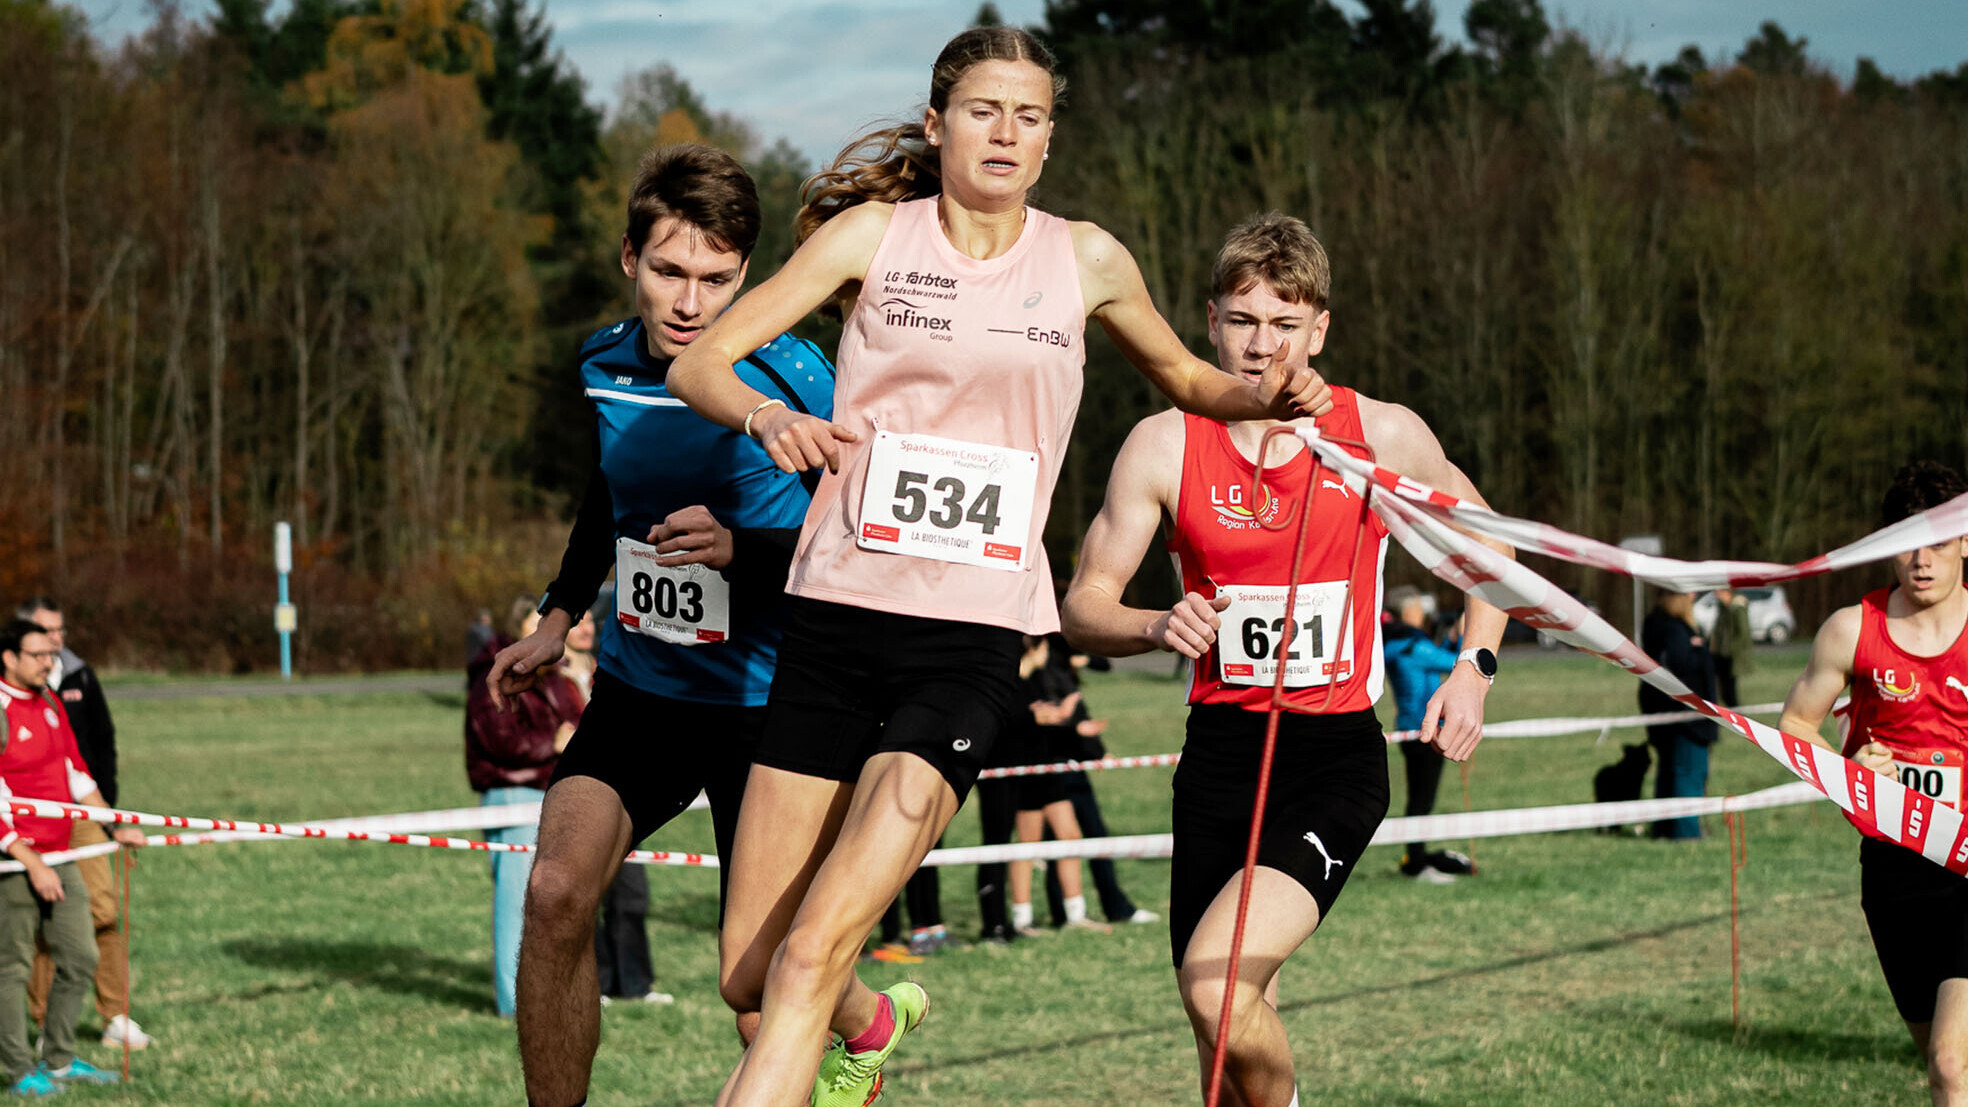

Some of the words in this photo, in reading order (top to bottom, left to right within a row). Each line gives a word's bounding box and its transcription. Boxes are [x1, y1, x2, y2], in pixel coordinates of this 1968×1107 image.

[883, 286, 957, 300] Nordschwarzwald
[886, 308, 952, 331] infinex
[929, 332, 953, 343] Group
[1027, 327, 1070, 348] EnBW
[615, 375, 633, 386] JAKO
[900, 440, 958, 458] Sparkassen
[959, 450, 989, 462] Cross
[892, 470, 1001, 535] 534
[1211, 484, 1242, 504] LG
[1216, 515, 1245, 530] Region
[911, 531, 920, 541] LA
[632, 571, 704, 623] 803
[1238, 592, 1284, 602] Sparkassen
[1241, 614, 1324, 660] 621
[1873, 668, 1895, 684] LG
[1896, 764, 1944, 798] 00
